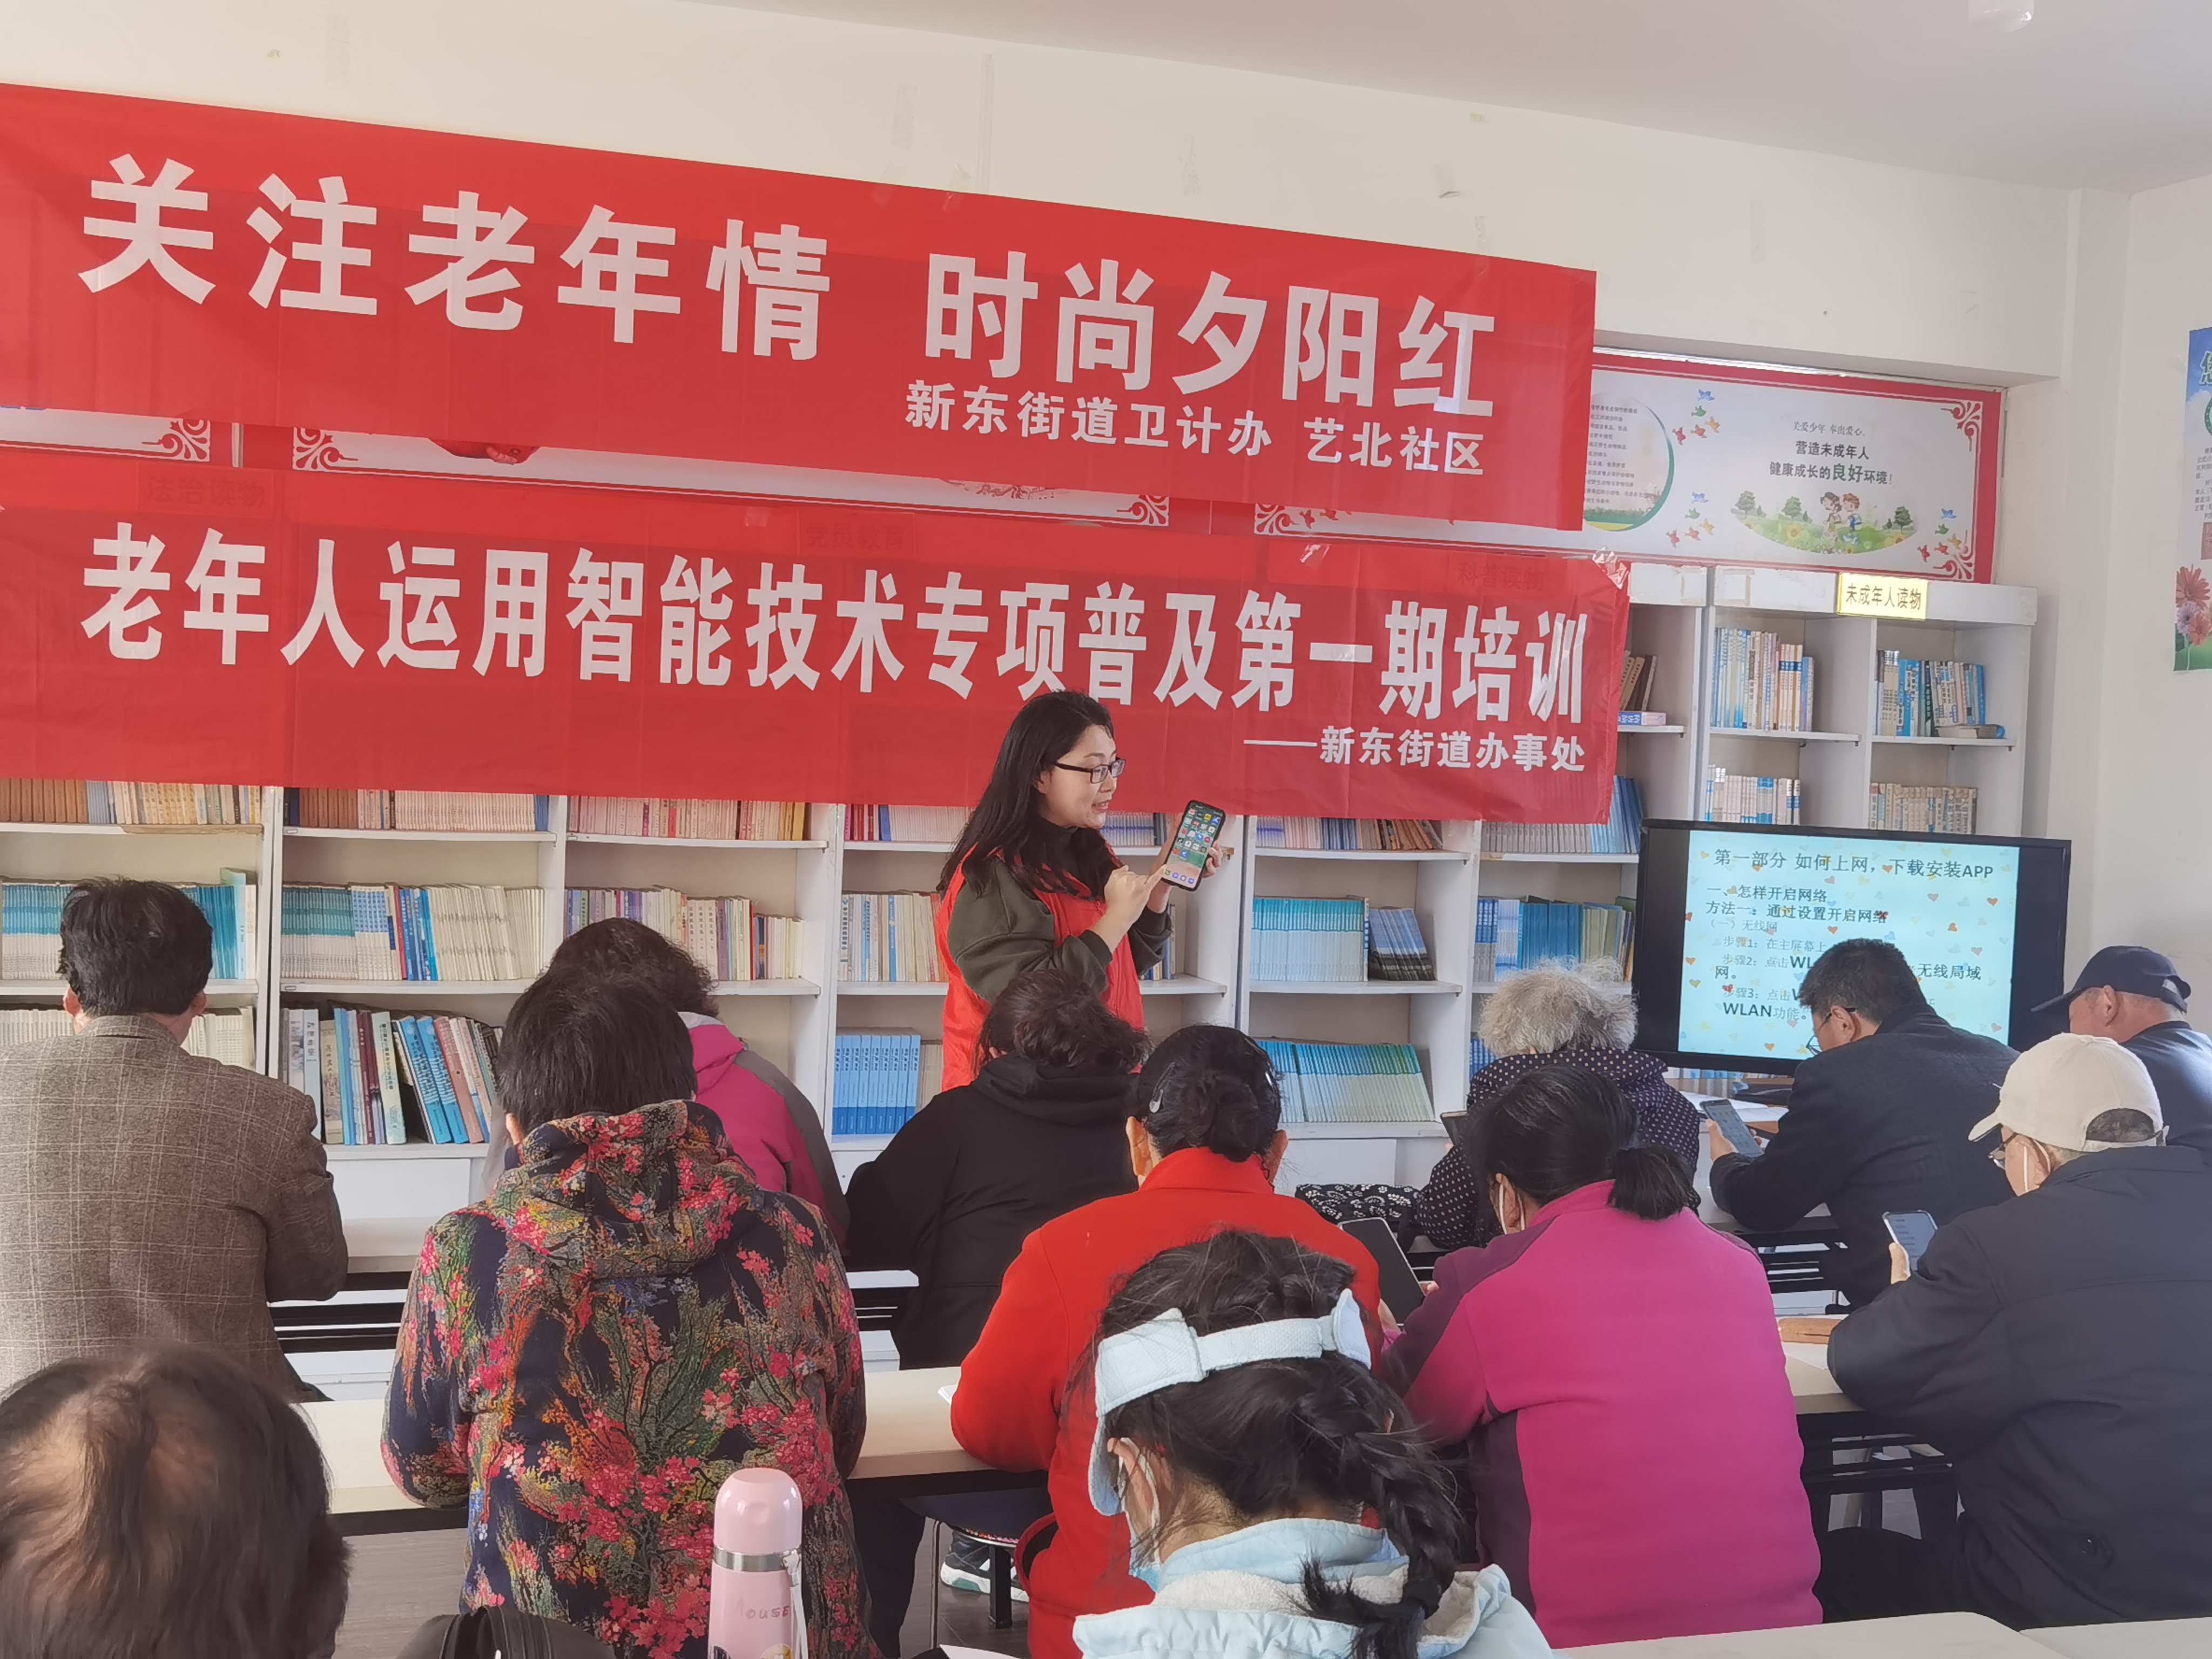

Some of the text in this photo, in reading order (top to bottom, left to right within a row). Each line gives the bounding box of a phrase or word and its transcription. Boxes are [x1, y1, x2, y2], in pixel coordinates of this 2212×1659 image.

[78, 153, 1495, 417] 关注老年情 时尚夕阳红
[905, 379, 1485, 475] 新东街道卫计办 艺北社区
[1796, 441, 1870, 460] 营造未成年人
[81, 522, 1588, 724] 老年人运用智能技术专项普及第一期培训
[1846, 583, 1921, 610] 未成年人读物
[1714, 848, 1788, 869] 第一部分
